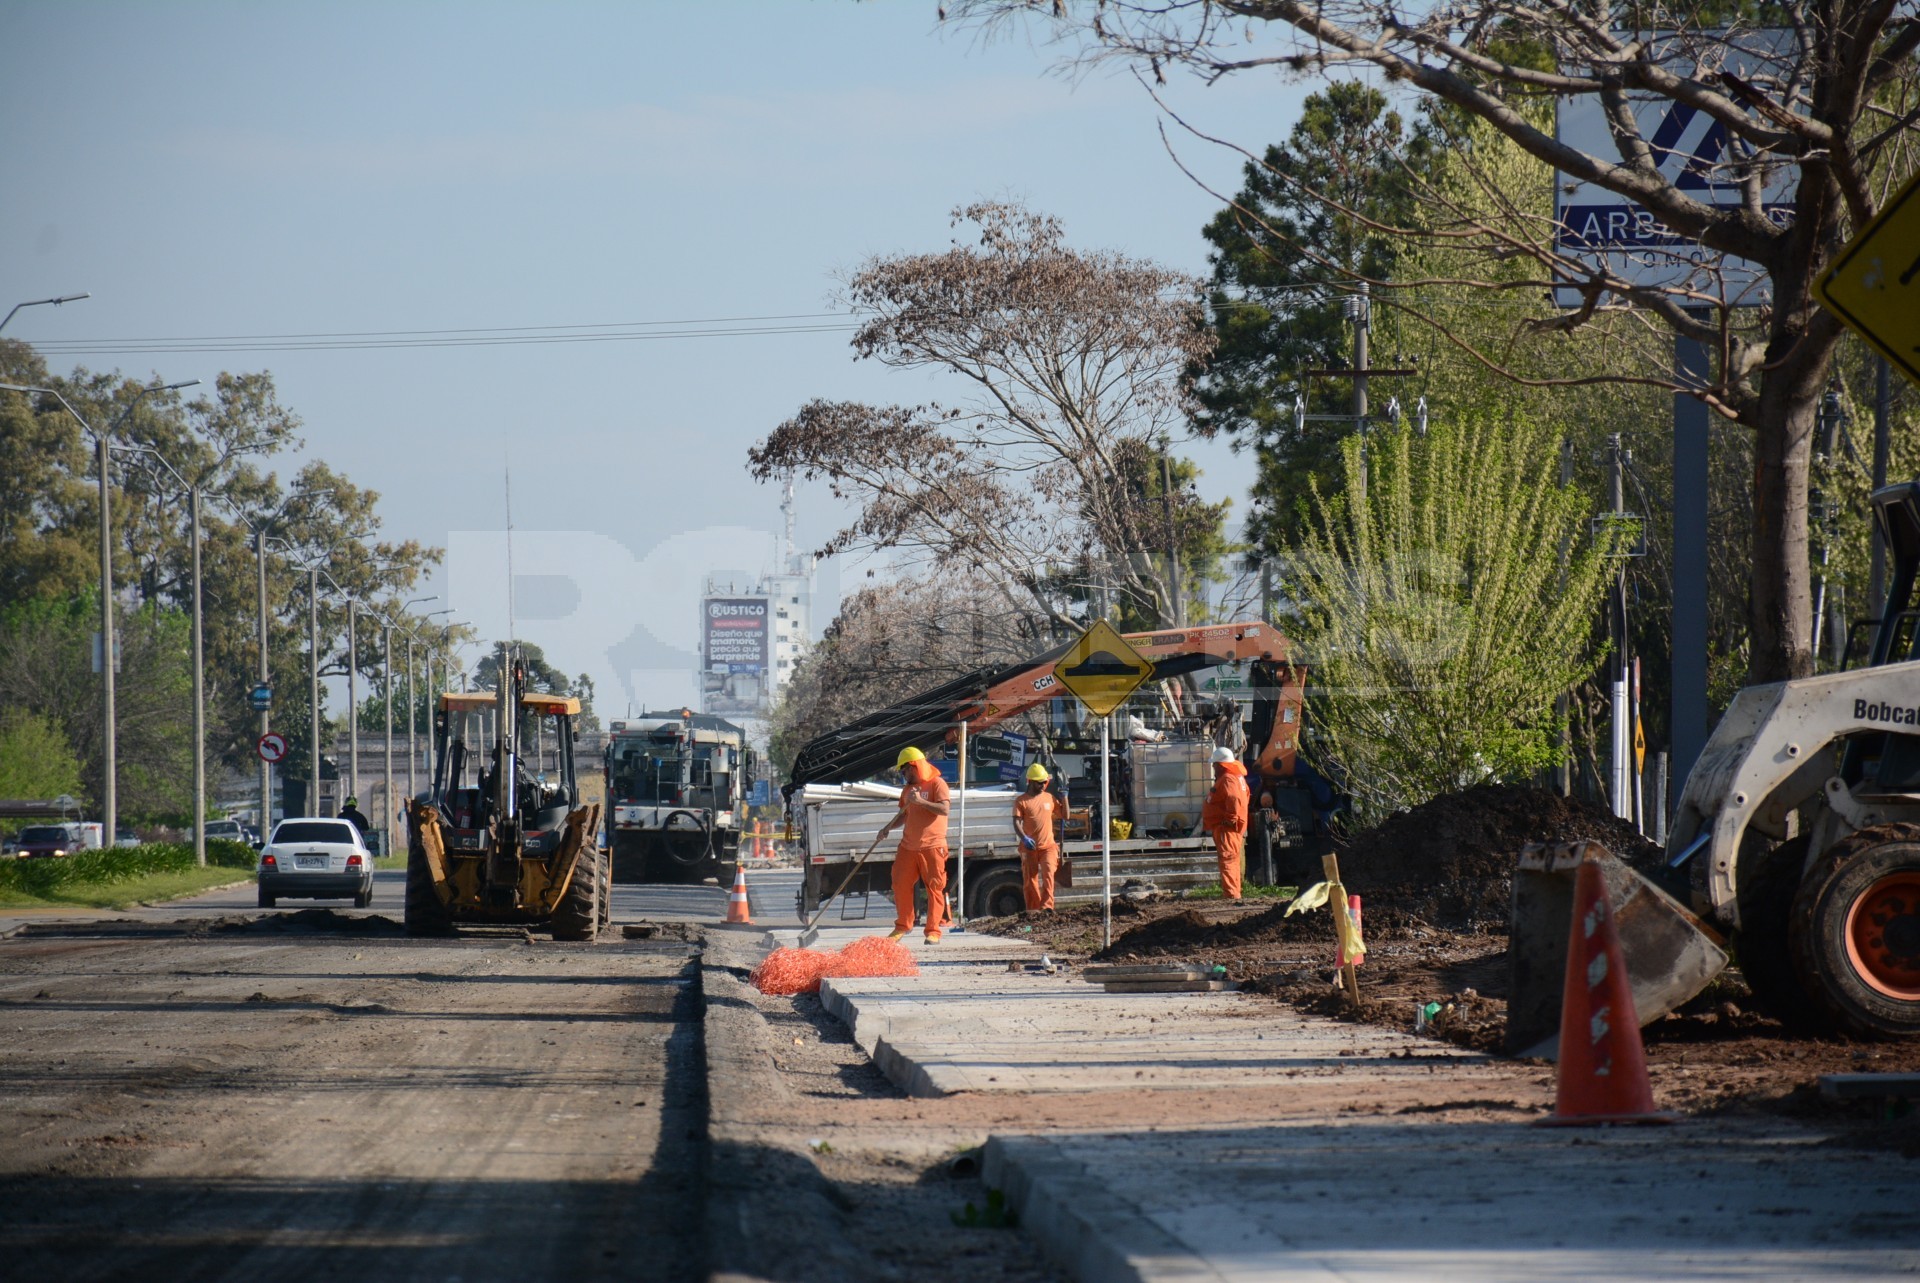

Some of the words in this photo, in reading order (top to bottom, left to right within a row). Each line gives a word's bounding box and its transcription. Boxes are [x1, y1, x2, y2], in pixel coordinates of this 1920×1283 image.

[710, 630, 743, 638] Diseño
[744, 630, 763, 640] que
[710, 645, 741, 653] precio
[742, 646, 761, 655] que
[710, 653, 761, 663] sorprende
[1033, 675, 1054, 690] CCH
[987, 746, 1011, 755] Paraguay
